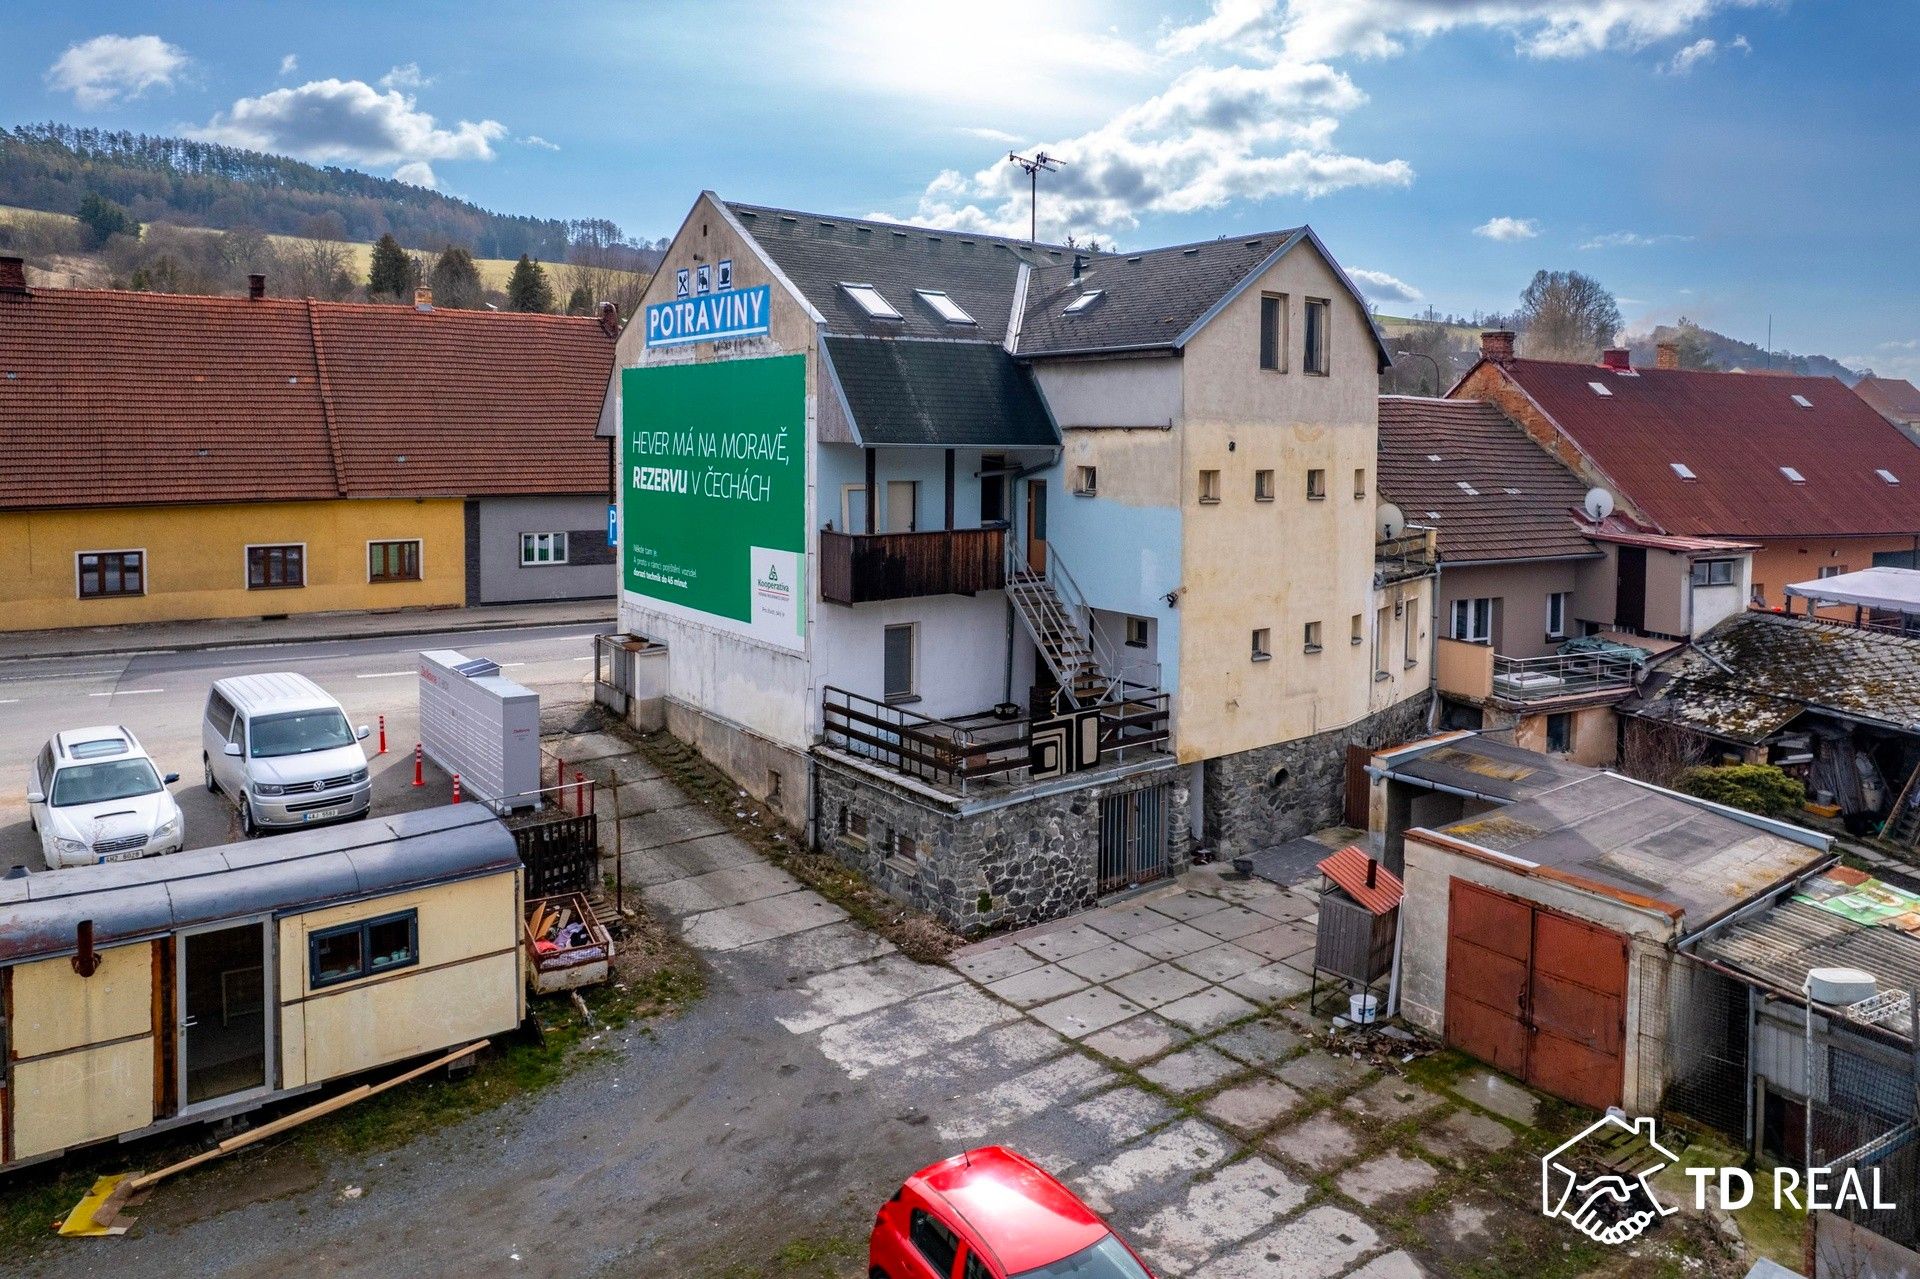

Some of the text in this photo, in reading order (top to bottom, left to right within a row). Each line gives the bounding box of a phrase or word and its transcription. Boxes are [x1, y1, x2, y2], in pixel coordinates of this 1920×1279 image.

[650, 290, 764, 337] POTRAVINY
[632, 426, 790, 466] HEVER MÁ NA MORAVĚ,
[632, 465, 771, 502] REZERVU V ČECHÁCH
[609, 509, 617, 539] P
[757, 578, 790, 592] Kooperativa
